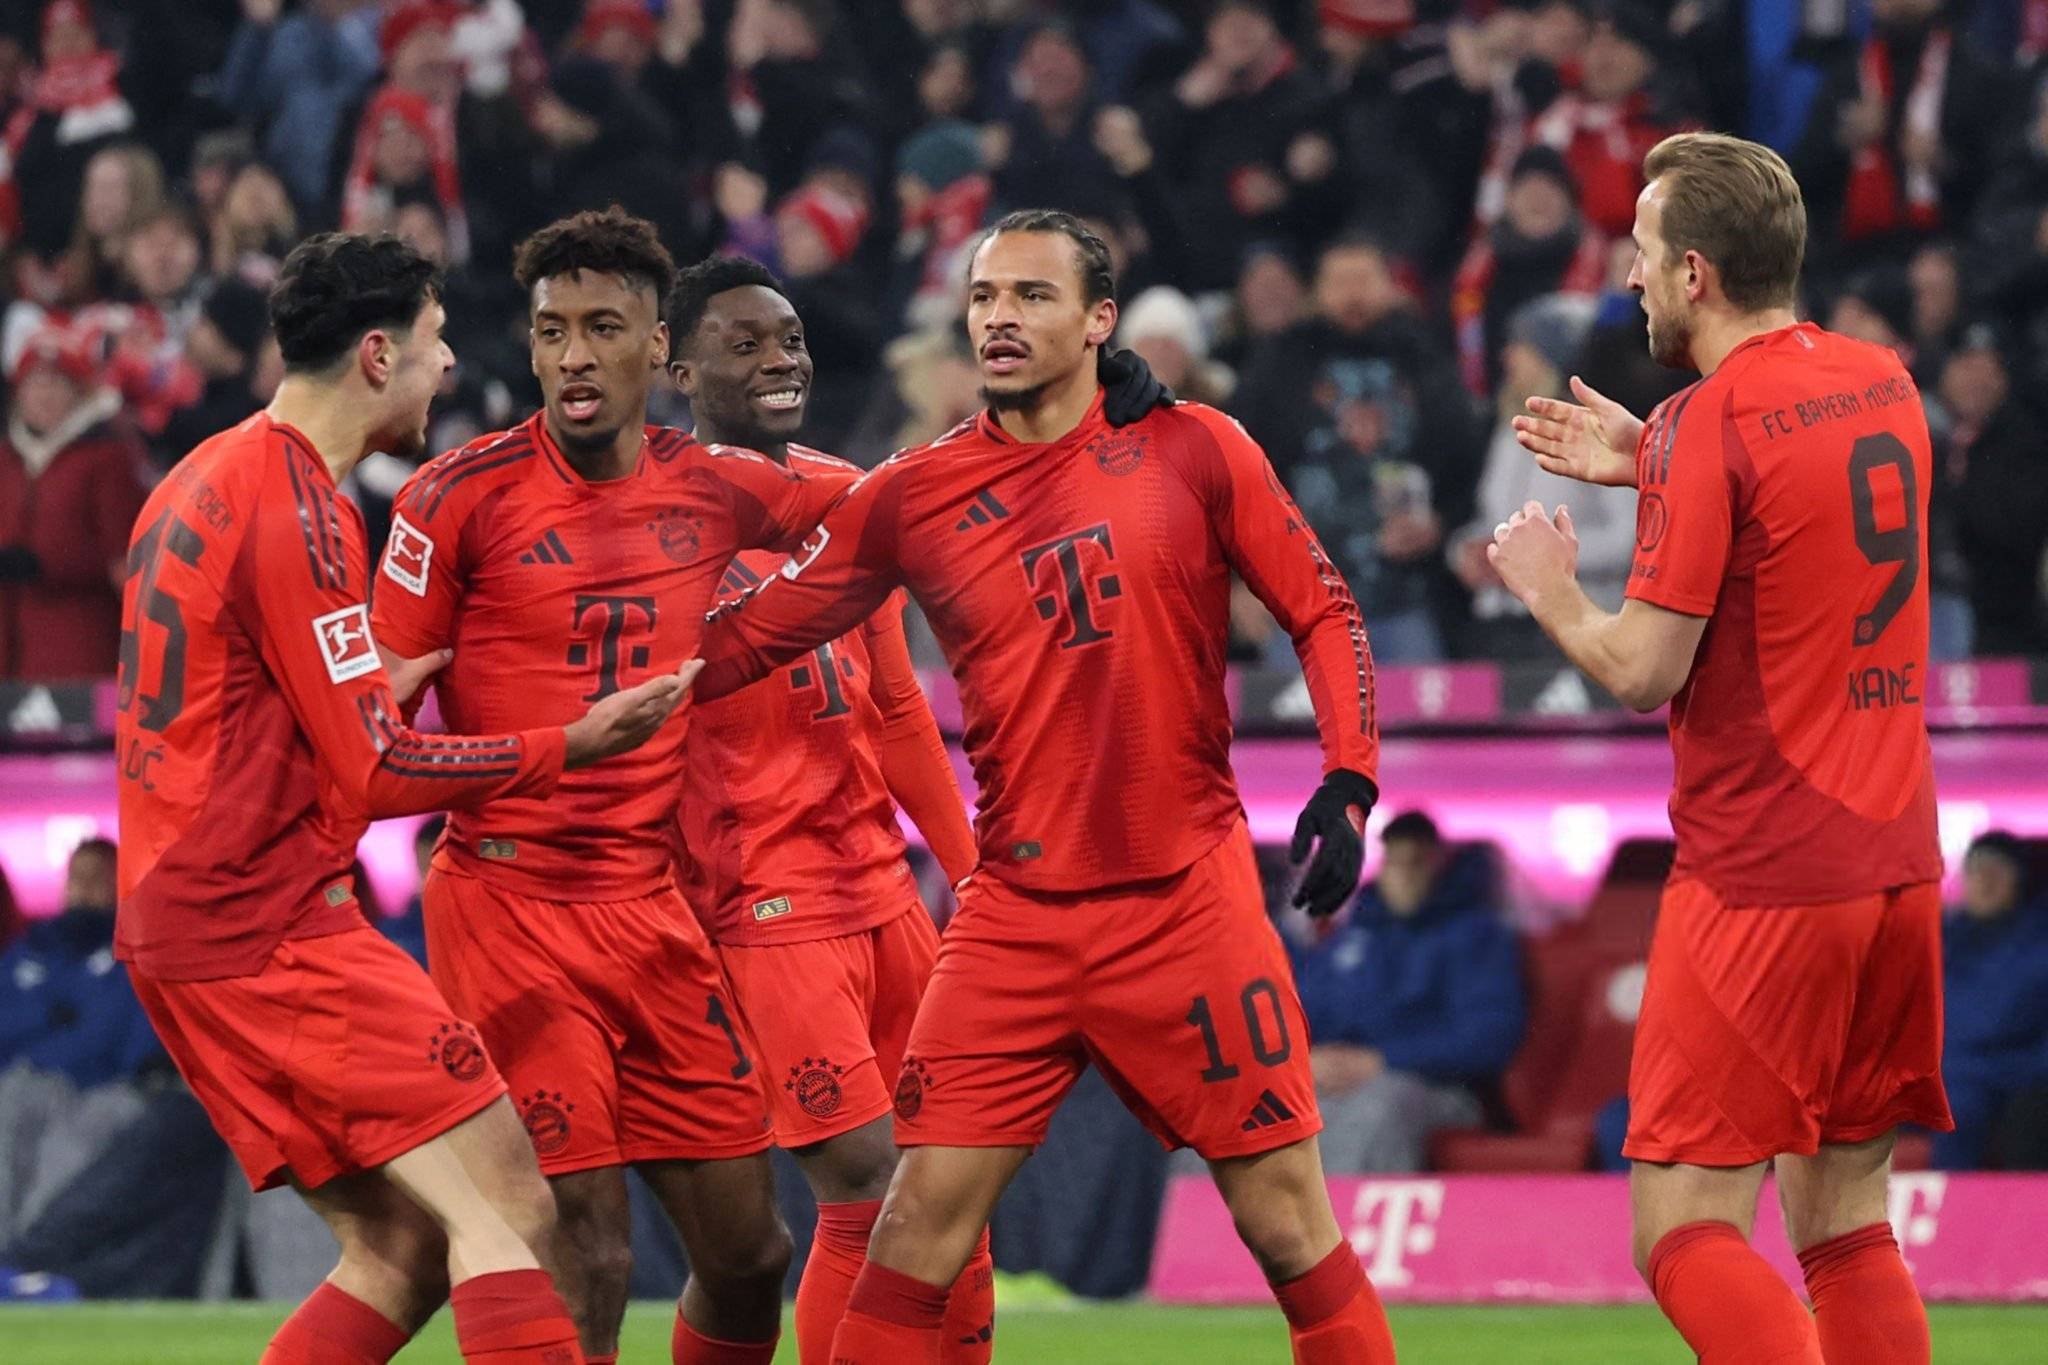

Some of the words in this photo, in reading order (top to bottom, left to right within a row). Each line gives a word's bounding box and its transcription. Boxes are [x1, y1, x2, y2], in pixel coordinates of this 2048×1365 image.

[1761, 410, 1793, 439] FC
[1795, 392, 1863, 428] BAYERN
[1021, 523, 1122, 648] T
[1848, 432, 1919, 647] 9
[566, 595, 656, 701] T
[1846, 662, 1919, 711] KANE
[1185, 978, 1291, 1082] 10
[1351, 1180, 1445, 1287] T
